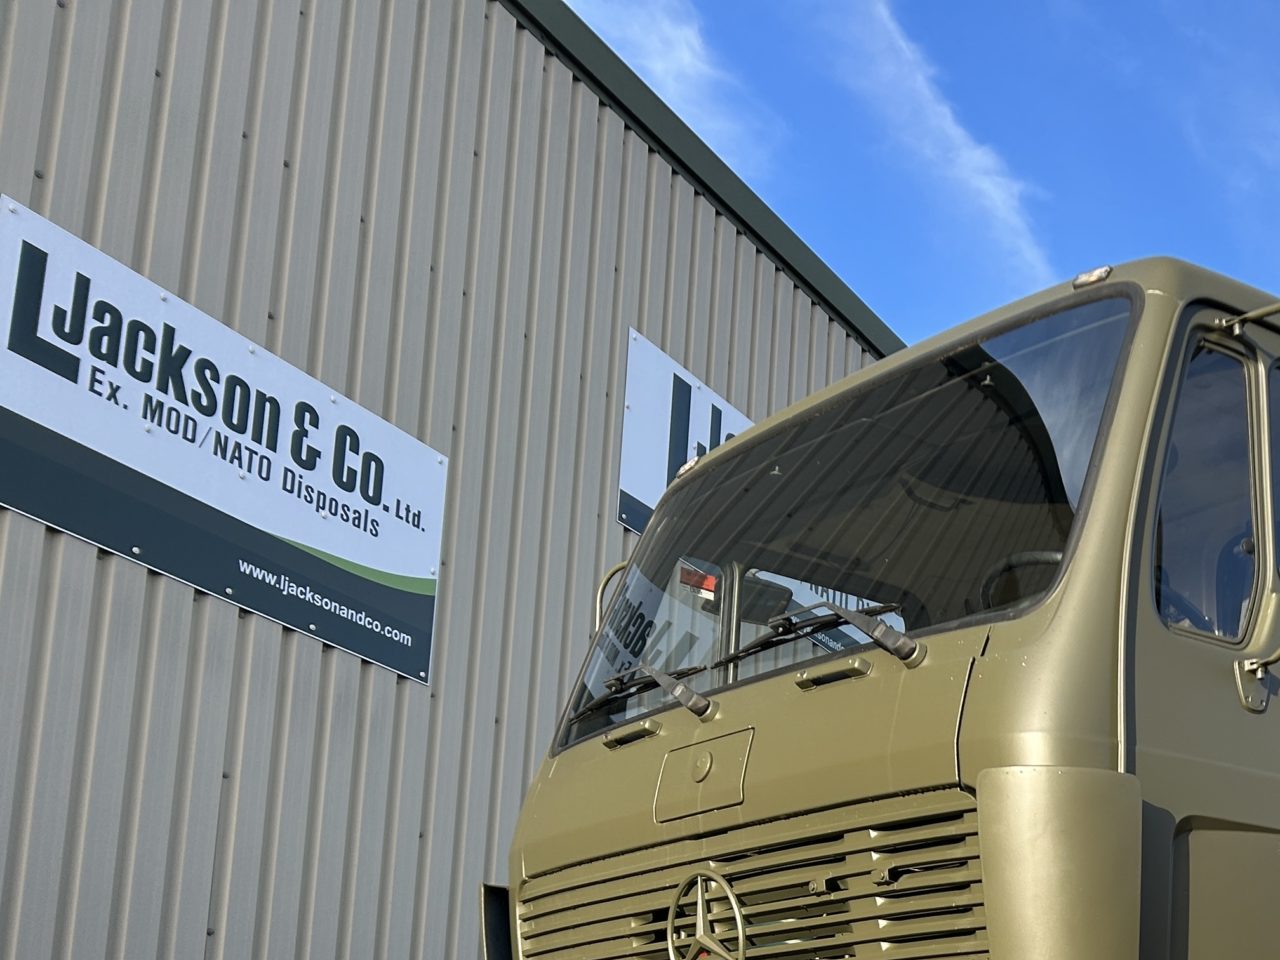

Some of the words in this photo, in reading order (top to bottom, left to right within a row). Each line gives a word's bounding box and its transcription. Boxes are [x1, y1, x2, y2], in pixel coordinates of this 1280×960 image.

[88, 365, 129, 410] Ex.
[141, 394, 272, 482] MOD/NATO
[282, 471, 380, 538] Disposals
[291, 400, 322, 471] &
[333, 424, 390, 512] Co.
[394, 499, 427, 533] Ltd.
[238, 559, 412, 647] www.ljacksonandco.com
